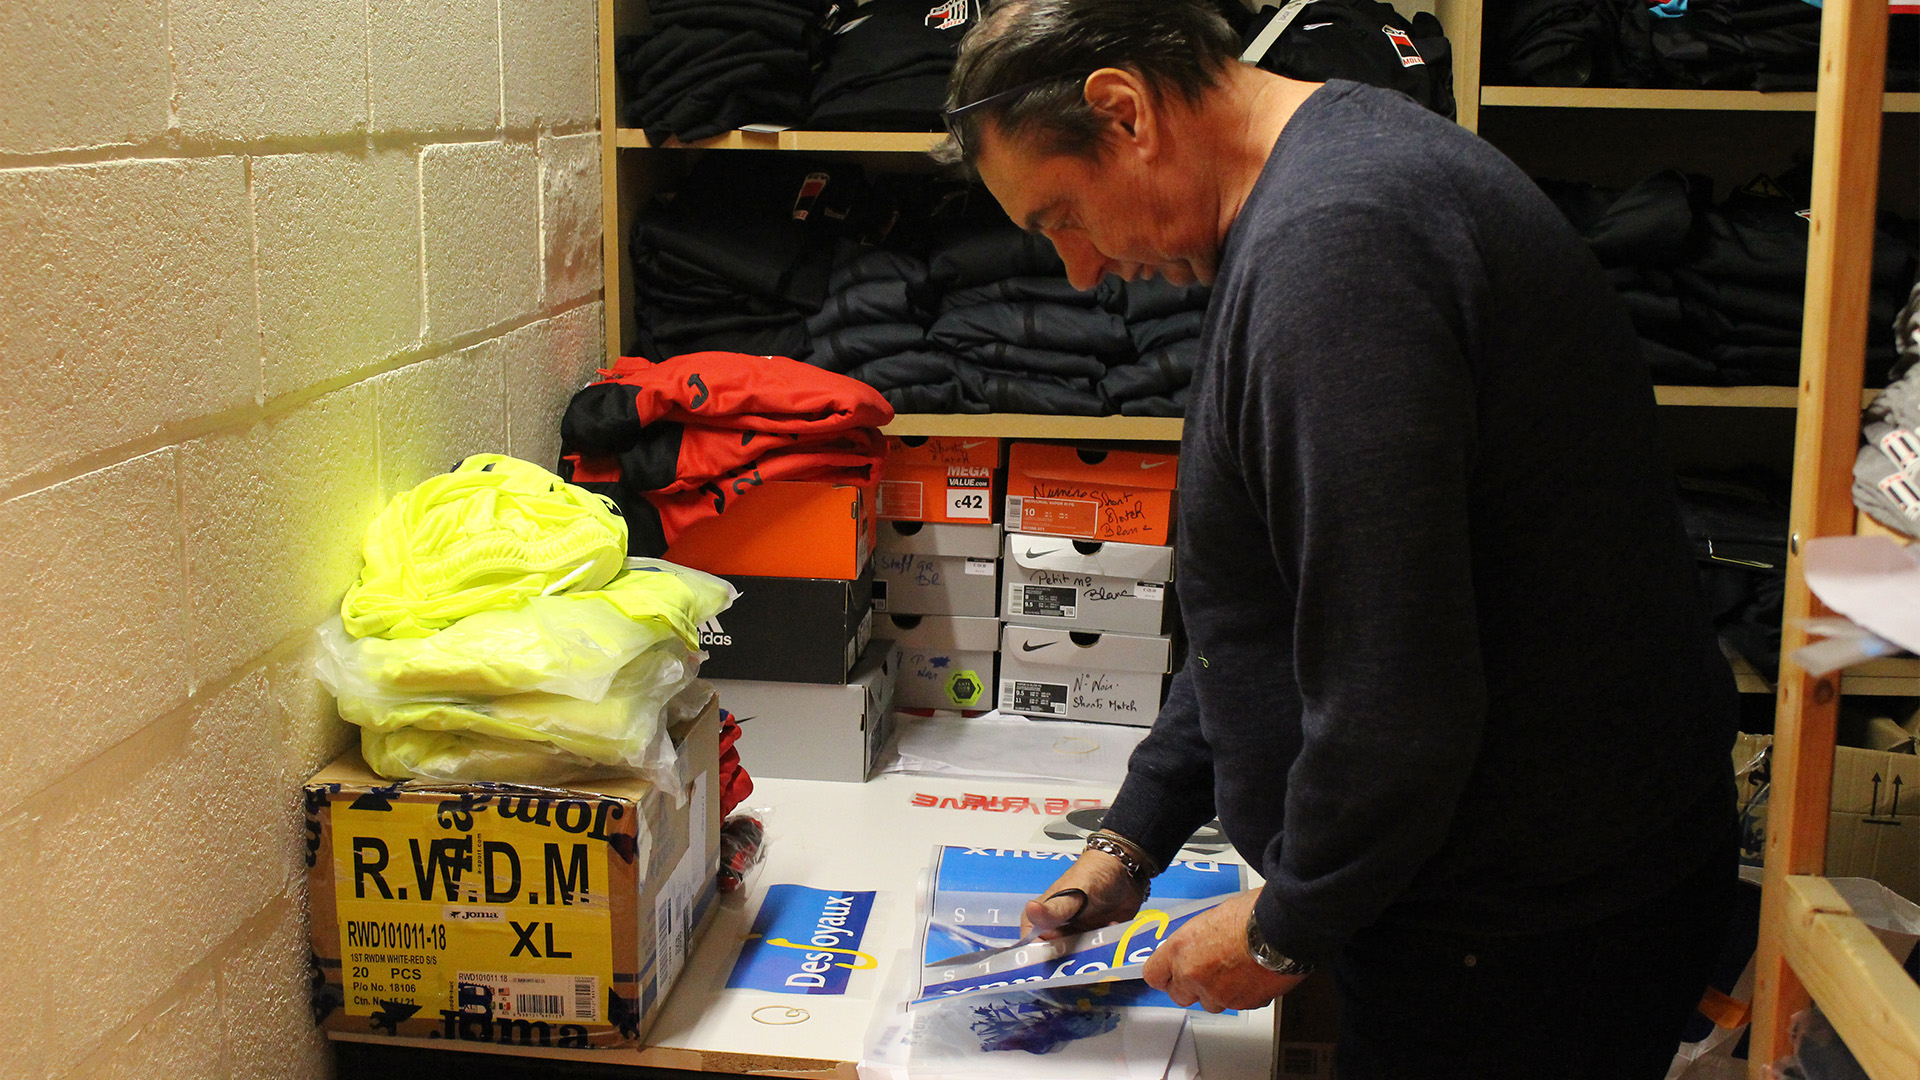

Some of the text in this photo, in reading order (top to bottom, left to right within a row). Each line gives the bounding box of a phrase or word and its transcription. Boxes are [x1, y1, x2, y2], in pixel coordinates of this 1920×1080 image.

[947, 466, 989, 477] MEGA
[1024, 508, 1036, 517] 10
[1030, 569, 1070, 586] Petit
[1083, 588, 1138, 601] Blanc
[697, 630, 732, 645] idas
[1109, 700, 1137, 712] Match
[352, 836, 590, 905] R.W.D.M
[347, 920, 573, 958] RWD101011-18 XL
[350, 953, 438, 966] 1ST RWDM WHITE-RED S/S
[352, 966, 422, 980] 20 PCS
[353, 982, 416, 993] P/o No. 18106
[353, 996, 371, 1006] Ctn.
